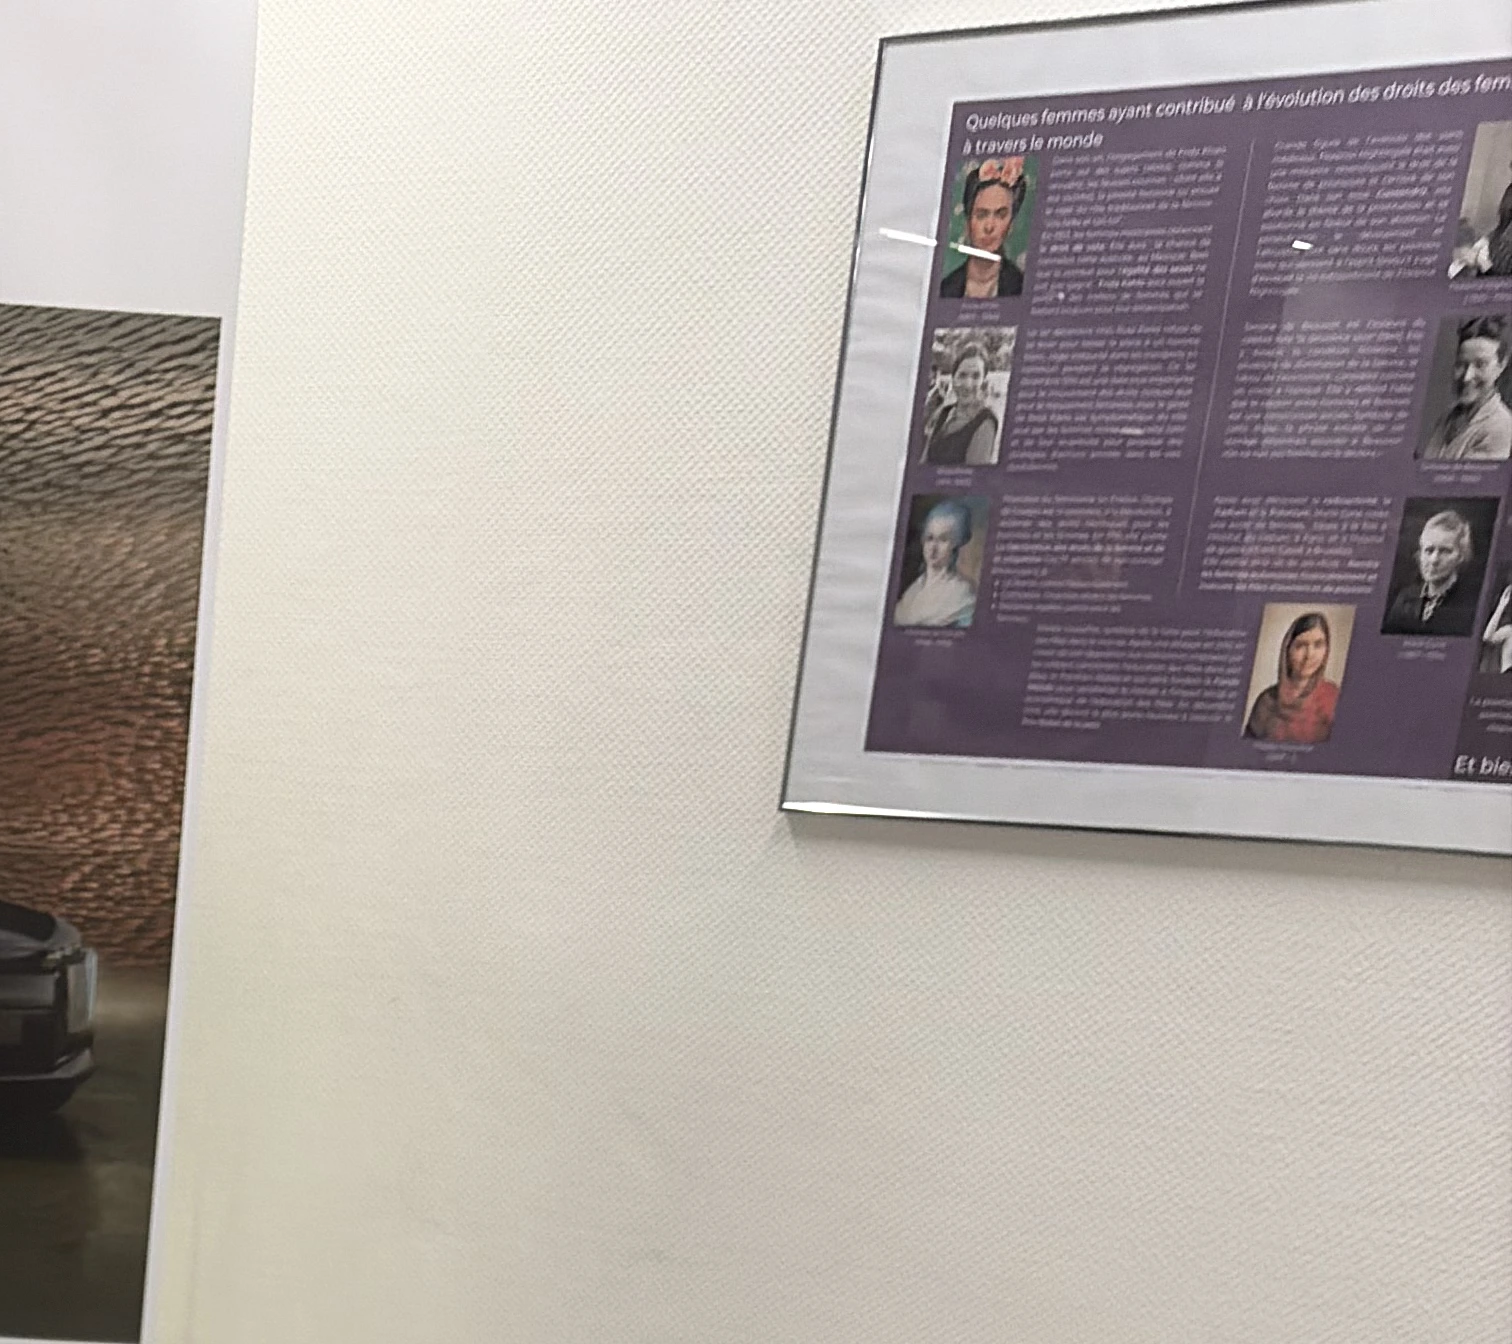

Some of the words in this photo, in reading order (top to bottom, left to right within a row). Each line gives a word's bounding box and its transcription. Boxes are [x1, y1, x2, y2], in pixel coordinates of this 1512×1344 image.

[966, 112, 1038, 132] Quelques
[1041, 107, 1105, 125] femmes
[1108, 102, 1153, 124] ayant
[1155, 94, 1235, 118] contribué
[1257, 86, 1345, 110] l'évolution
[1348, 84, 1381, 103] des
[1383, 79, 1436, 100] droits
[1438, 76, 1471, 96] des
[975, 134, 1027, 153] travers
[1030, 134, 1043, 150] le
[1046, 130, 1104, 150] monde
[1454, 755, 1476, 775] Et
